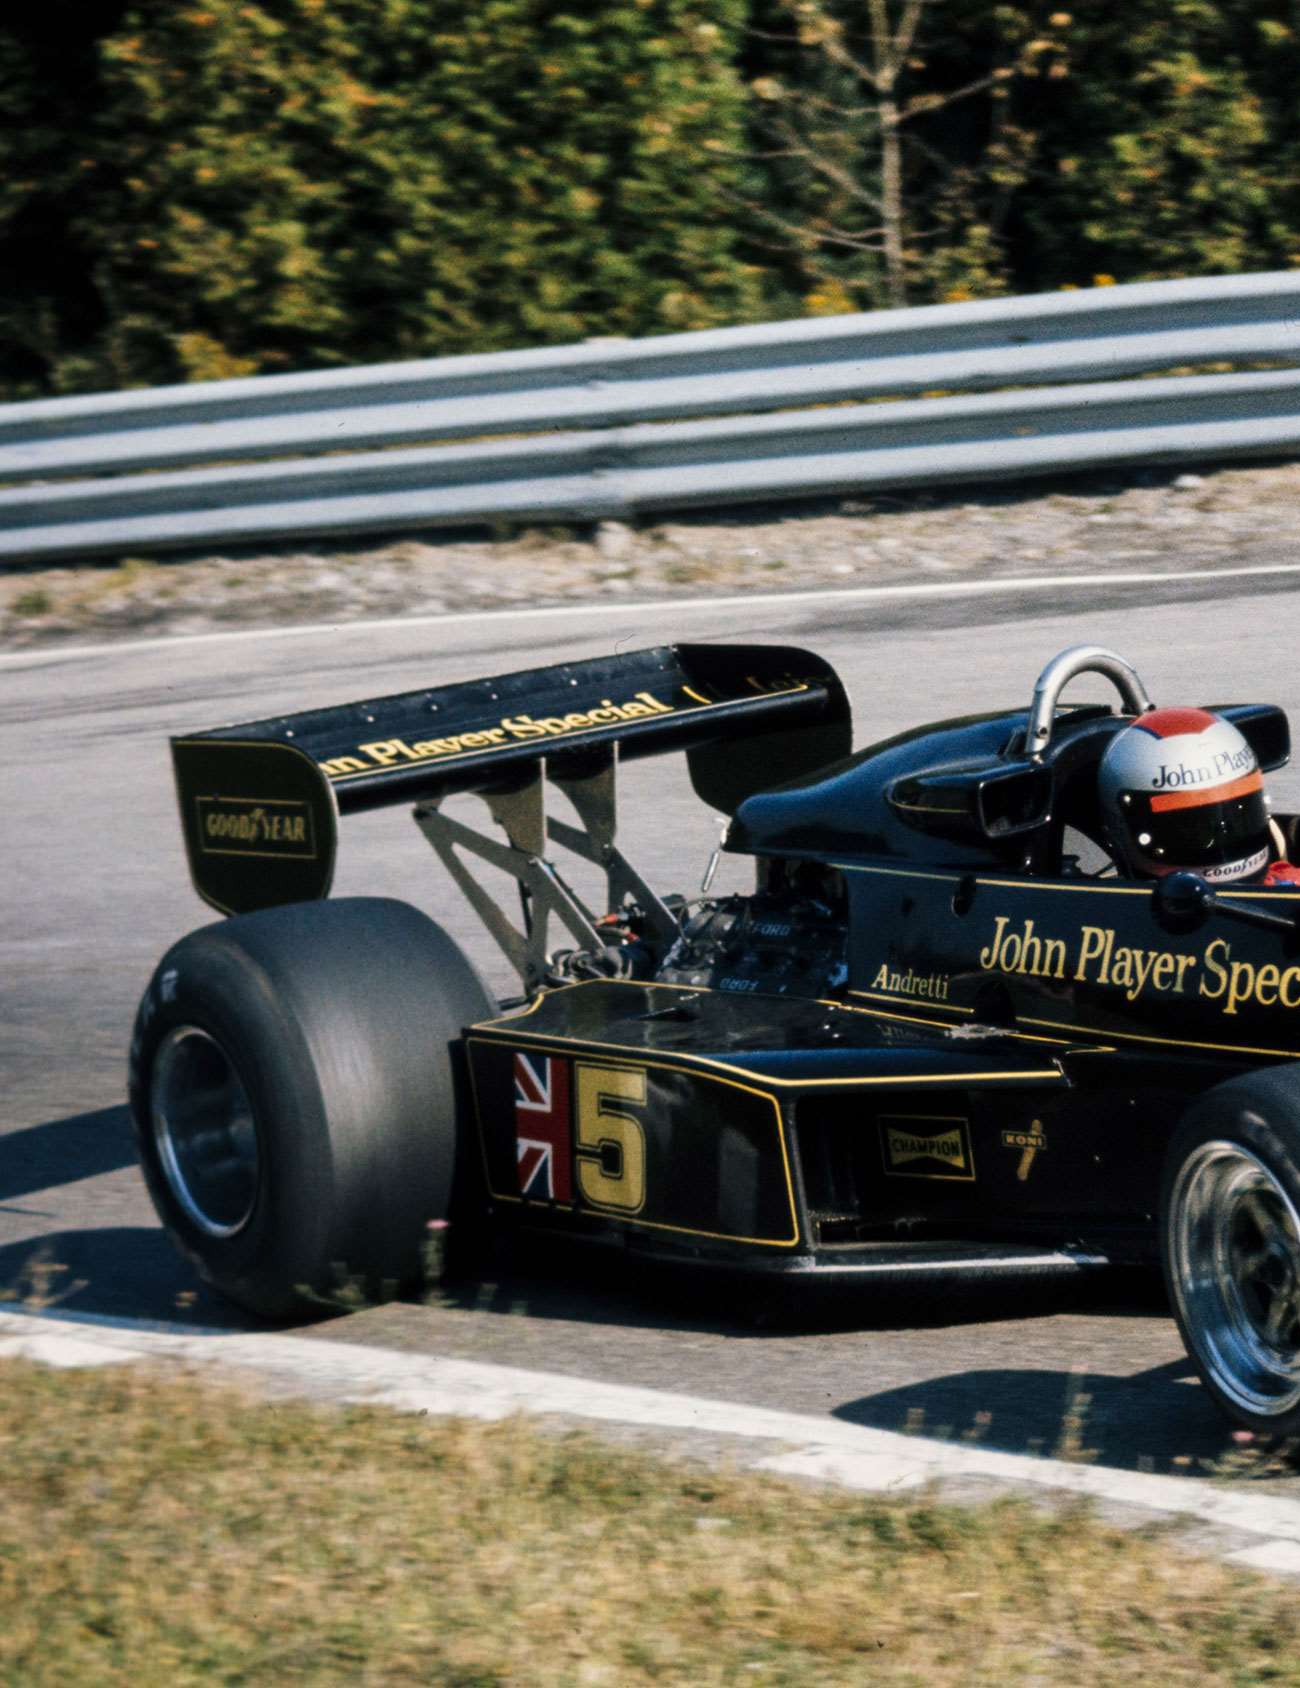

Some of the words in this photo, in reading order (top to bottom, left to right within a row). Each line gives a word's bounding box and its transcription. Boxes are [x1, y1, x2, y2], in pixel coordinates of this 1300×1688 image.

[358, 727, 508, 766] Player
[502, 691, 675, 738] Special
[1152, 763, 1211, 788] John
[980, 917, 1067, 979] John
[1074, 926, 1197, 1000] Player
[871, 963, 950, 1000] Andretti
[573, 1060, 647, 1216] 5
[891, 1136, 960, 1157] CHAMPION
[1005, 1133, 1043, 1147] KONI
